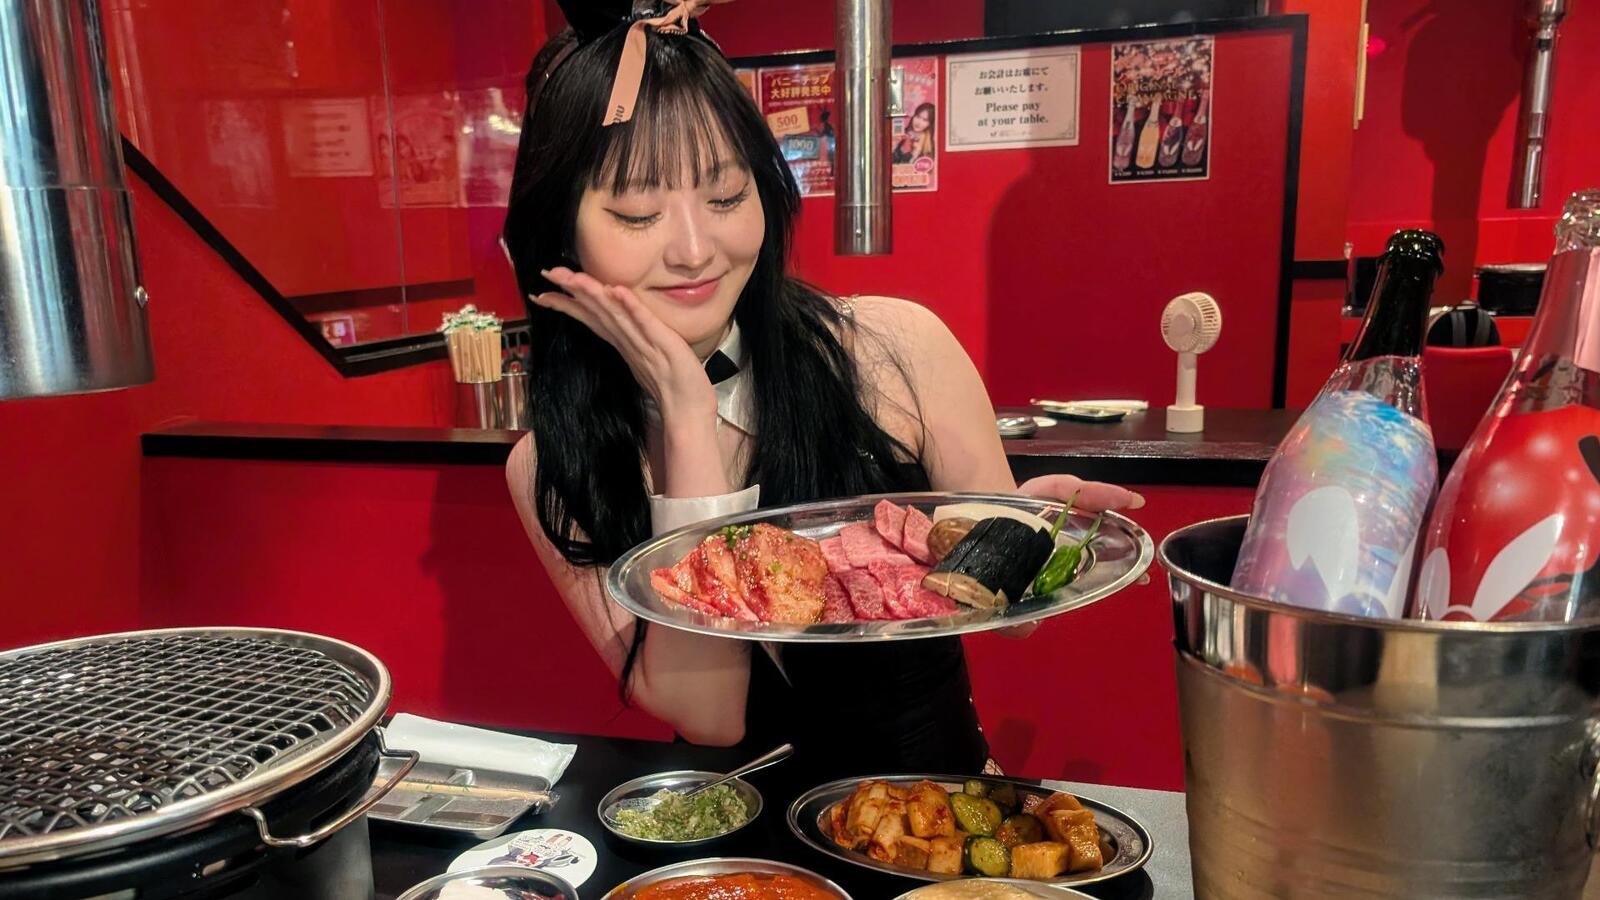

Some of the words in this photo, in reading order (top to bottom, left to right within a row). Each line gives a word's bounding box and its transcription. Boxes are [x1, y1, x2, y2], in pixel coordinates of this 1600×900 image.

[771, 85, 832, 99] 大好評発売中
[986, 102, 1019, 112] Please
[1022, 101, 1040, 112] pay
[777, 114, 798, 128] 500
[978, 118, 988, 127] at
[991, 117, 1016, 128] your
[1019, 113, 1049, 124] table.
